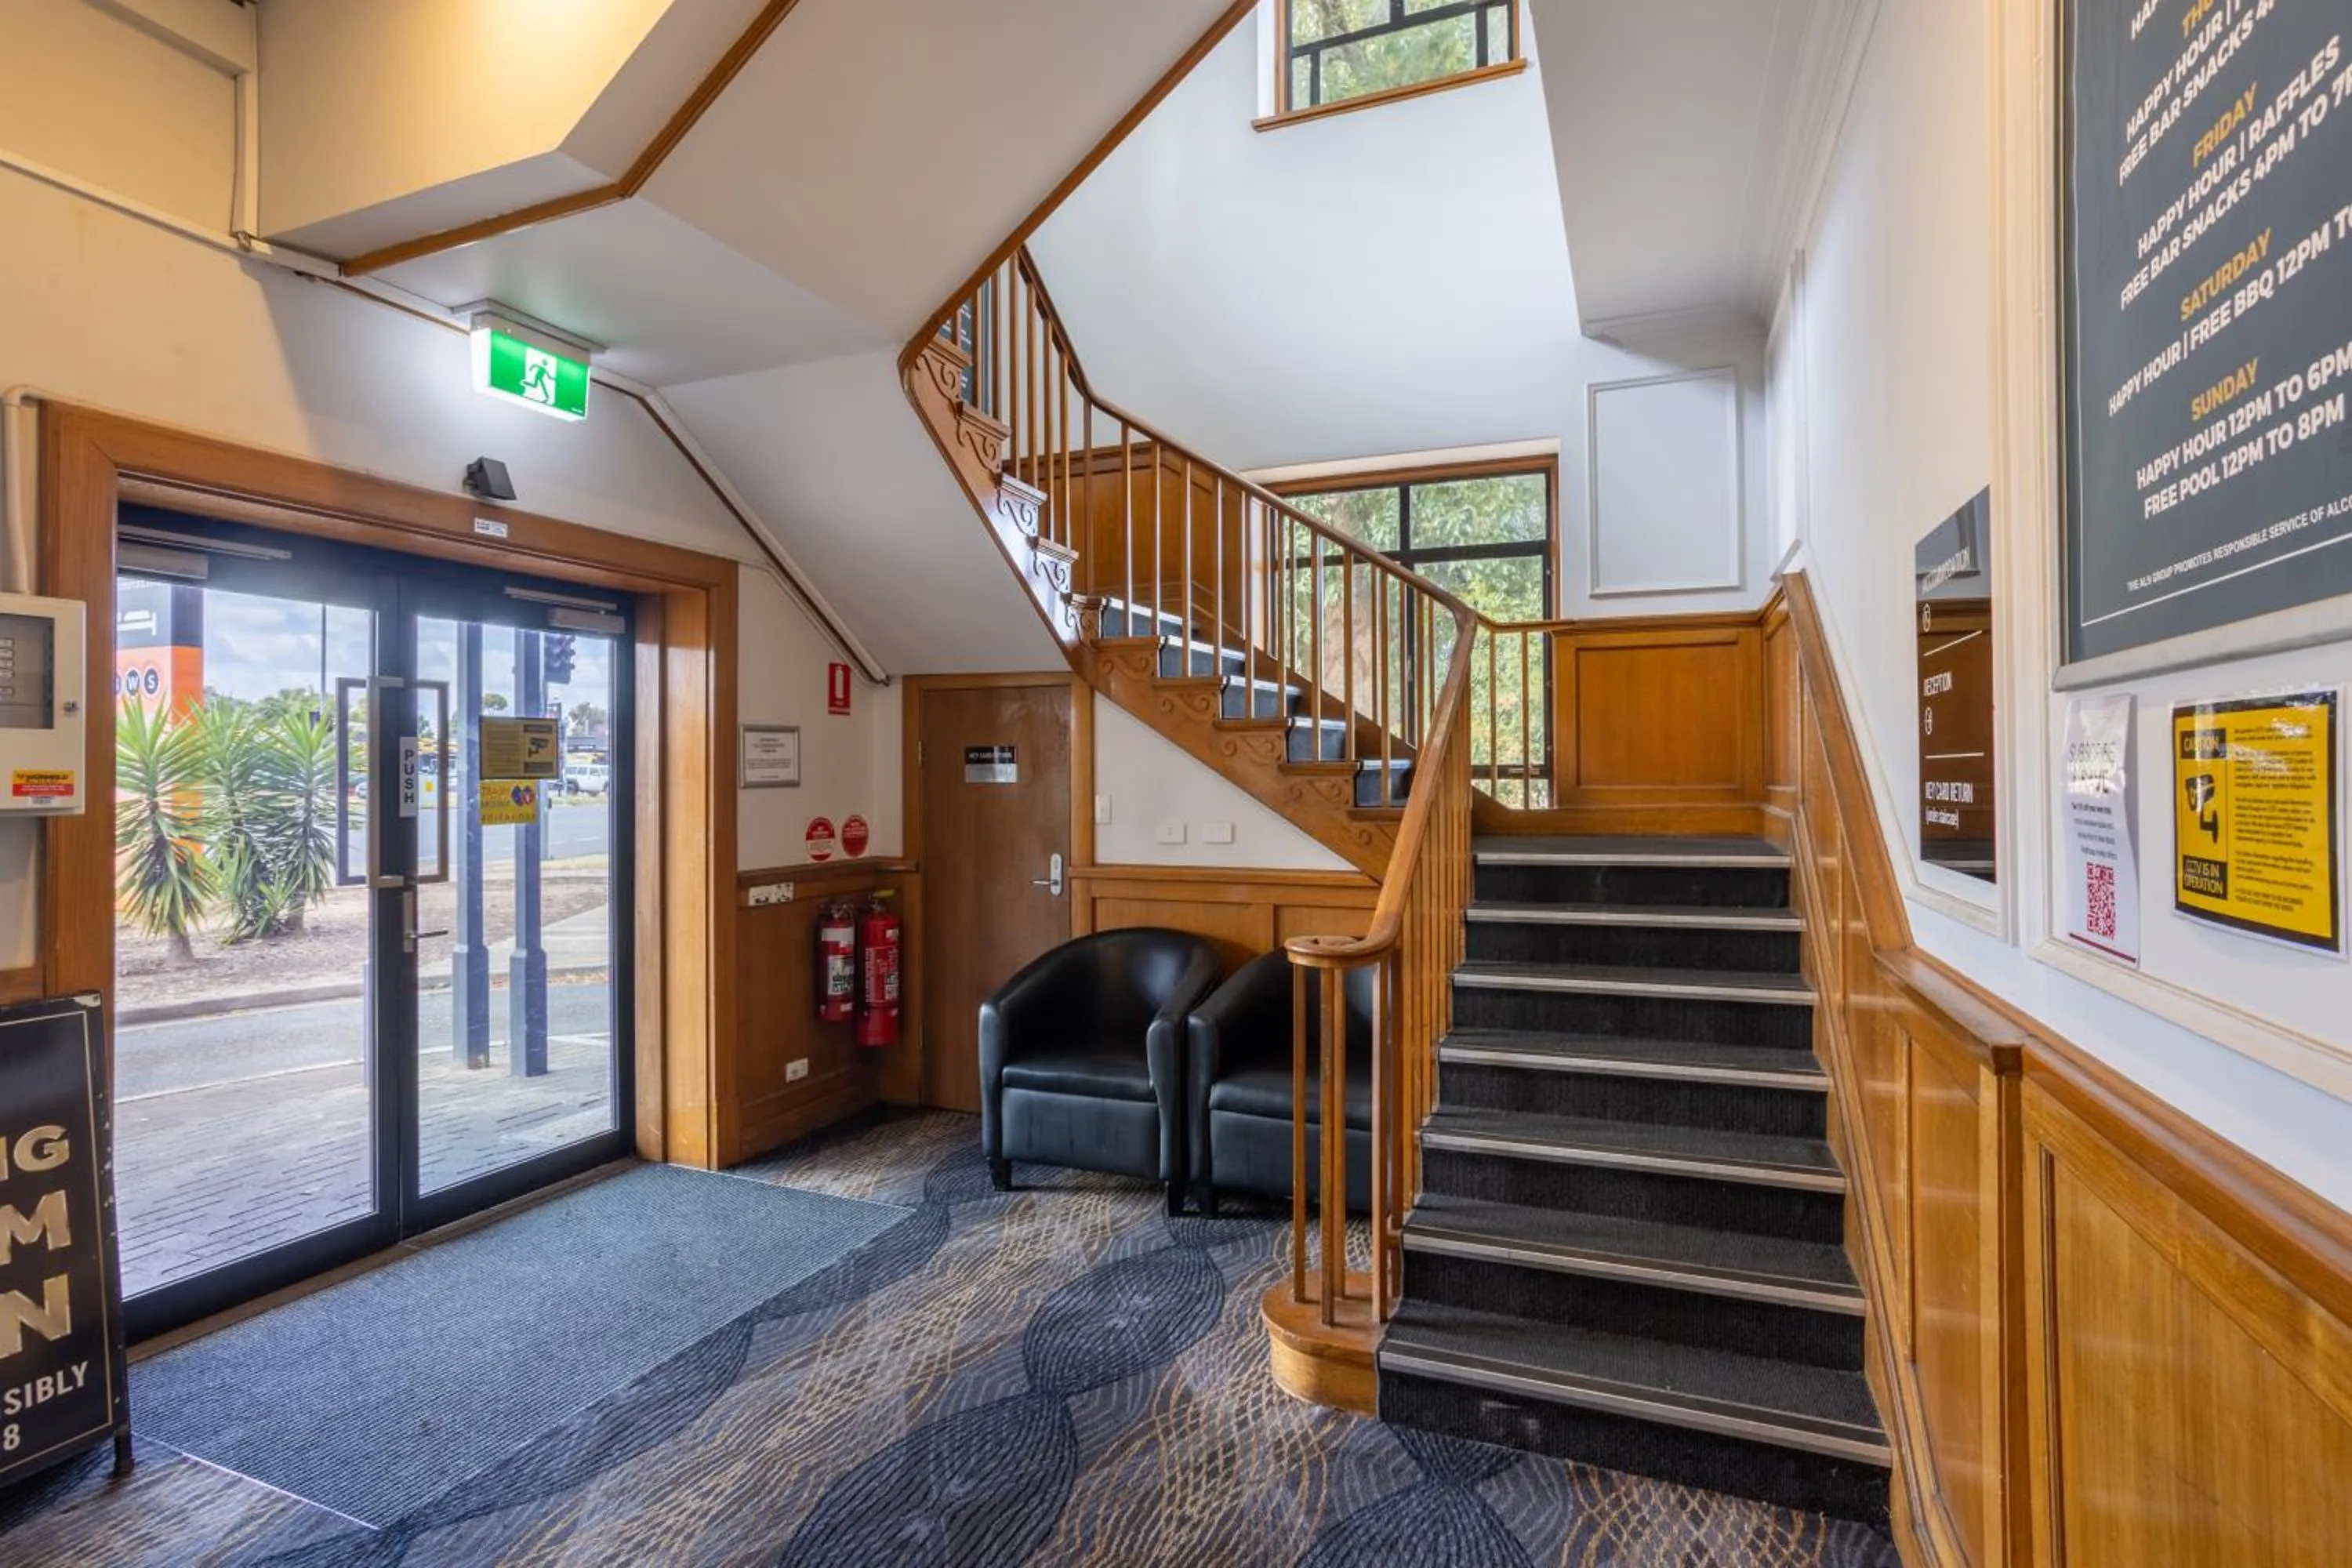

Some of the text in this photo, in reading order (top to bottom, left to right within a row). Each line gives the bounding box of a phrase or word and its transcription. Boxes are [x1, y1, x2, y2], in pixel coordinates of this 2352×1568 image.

[2119, 134, 2148, 187] FREE
[2150, 96, 2181, 147] BAR
[2183, 8, 2253, 107] SNACKS
[2126, 69, 2174, 142] HAPPY
[2176, 9, 2223, 83] HOUR
[2193, 82, 2257, 168] FRIDAY
[2138, 194, 2186, 259] HAPPY
[2188, 147, 2236, 209] HOUR
[2249, 34, 2339, 151] RAFFLES
[2121, 266, 2149, 311] FREE
[2151, 236, 2180, 280] BAR
[2182, 169, 2251, 250] SNACKS
[2253, 123, 2296, 181] 4PM
[2299, 93, 2328, 138] TO
[2109, 371, 2142, 417] HAPPY
[2143, 341, 2181, 387] HOUR
[2190, 299, 2231, 351] FREE
[2234, 269, 2274, 318] BBQ
[2276, 221, 2330, 285] 12PM
[2181, 227, 2270, 321] SATURDAY
[2136, 341, 2352, 489] HAPPY HOUR 12PM TO 6PM
[2191, 358, 2258, 421] SUNDAY
[2144, 393, 2345, 520] FREE POOL 12PM TO 8PM
[2173, 550, 2212, 575] PROMOTES
[2212, 528, 2268, 560] RESPONSIBLE
[2269, 512, 2308, 539] SERVICE
[2310, 506, 2325, 524] OF
[404, 749, 415, 804] PUSH
[3, 1423, 20, 1451] 8
[4, 1361, 88, 1415] SIBLY
